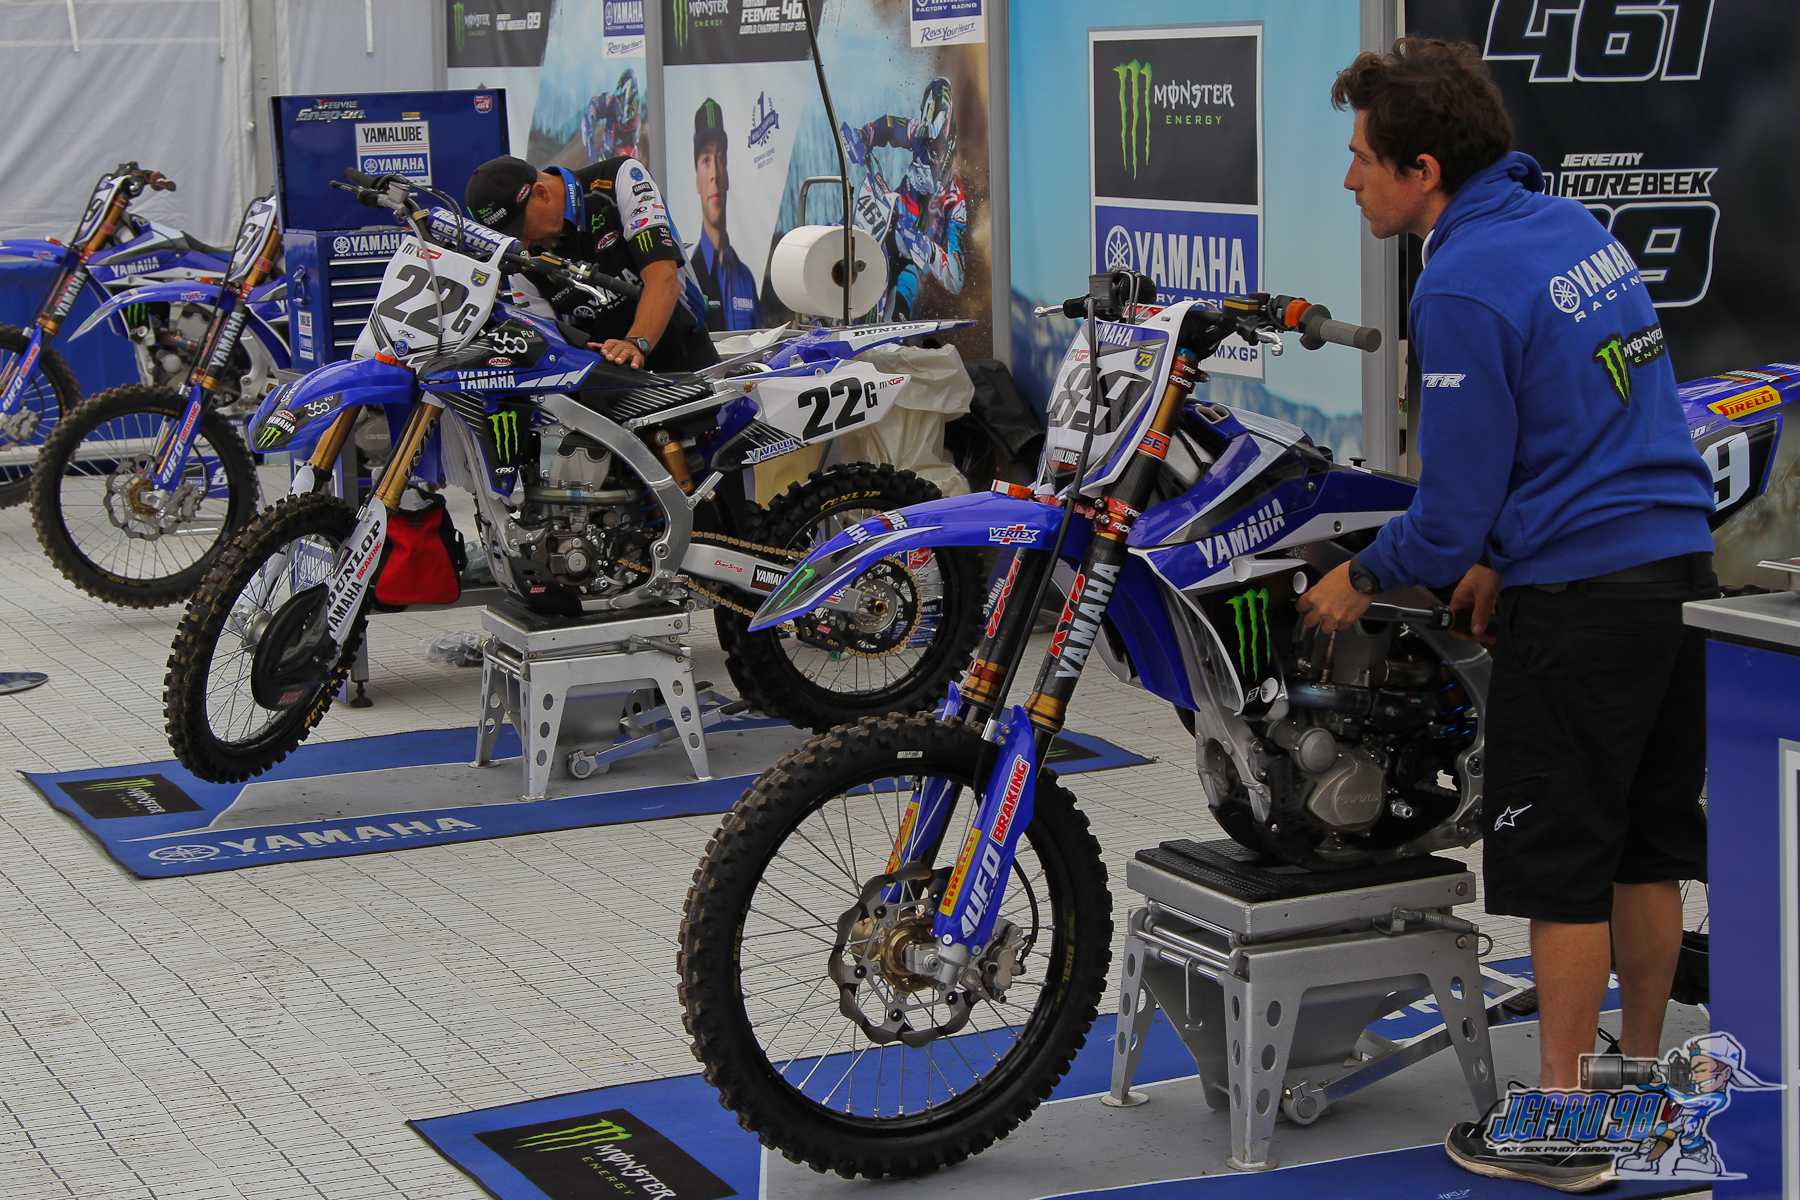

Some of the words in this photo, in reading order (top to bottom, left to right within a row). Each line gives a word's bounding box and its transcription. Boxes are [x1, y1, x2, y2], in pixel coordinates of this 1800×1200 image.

[613, 1, 643, 24] YAMAHA
[689, 0, 728, 17] MONSTER
[741, 6, 780, 23] FEBVRE
[526, 12, 541, 29] 89
[921, 26, 942, 43] Revs
[1482, 0, 1715, 82] 461
[1154, 79, 1235, 110] MONSTER
[1166, 115, 1222, 124] ENERGY
[362, 126, 422, 143] YAMALUBE
[378, 157, 425, 171] YAMAHA
[1561, 152, 1644, 167] JEREMY
[1560, 168, 1718, 200] HOREBEEK
[856, 195, 886, 235] 461
[110, 256, 160, 278] YAMAHA
[1134, 231, 1247, 295] YAMAHA
[474, 273, 486, 284] 73
[54, 270, 88, 318] YAMAHA
[210, 311, 245, 368] YAMAHA
[853, 324, 926, 337] DUNLOP
[487, 332, 528, 354] 360
[1214, 344, 1258, 362] MXGP
[1136, 353, 1153, 367] 73
[458, 370, 516, 389] YAMAHA
[880, 376, 904, 390] MXGP
[1169, 374, 1192, 388] ROCS
[304, 401, 330, 417] 360
[1717, 390, 1774, 416] PIRELLI
[180, 401, 200, 443] BRAKING
[266, 416, 295, 434] YAMAHA
[762, 439, 794, 455] VALLI
[1114, 500, 1141, 517] XTRI
[990, 528, 1036, 539] VERTEX
[1195, 498, 1286, 568] YAMAHA
[327, 520, 381, 611] DUNLOP
[356, 541, 382, 580] BRAKING
[329, 580, 362, 633] YAMAHA
[1055, 562, 1121, 678] YAMAHA
[993, 761, 1029, 842] BRAKING
[218, 818, 476, 854] YAMAHA
[964, 843, 1001, 935] UFO
[1062, 945, 1075, 982] EXCEL
[581, 1156, 635, 1196] ENERGY
[594, 1144, 676, 1200] MONSTER
